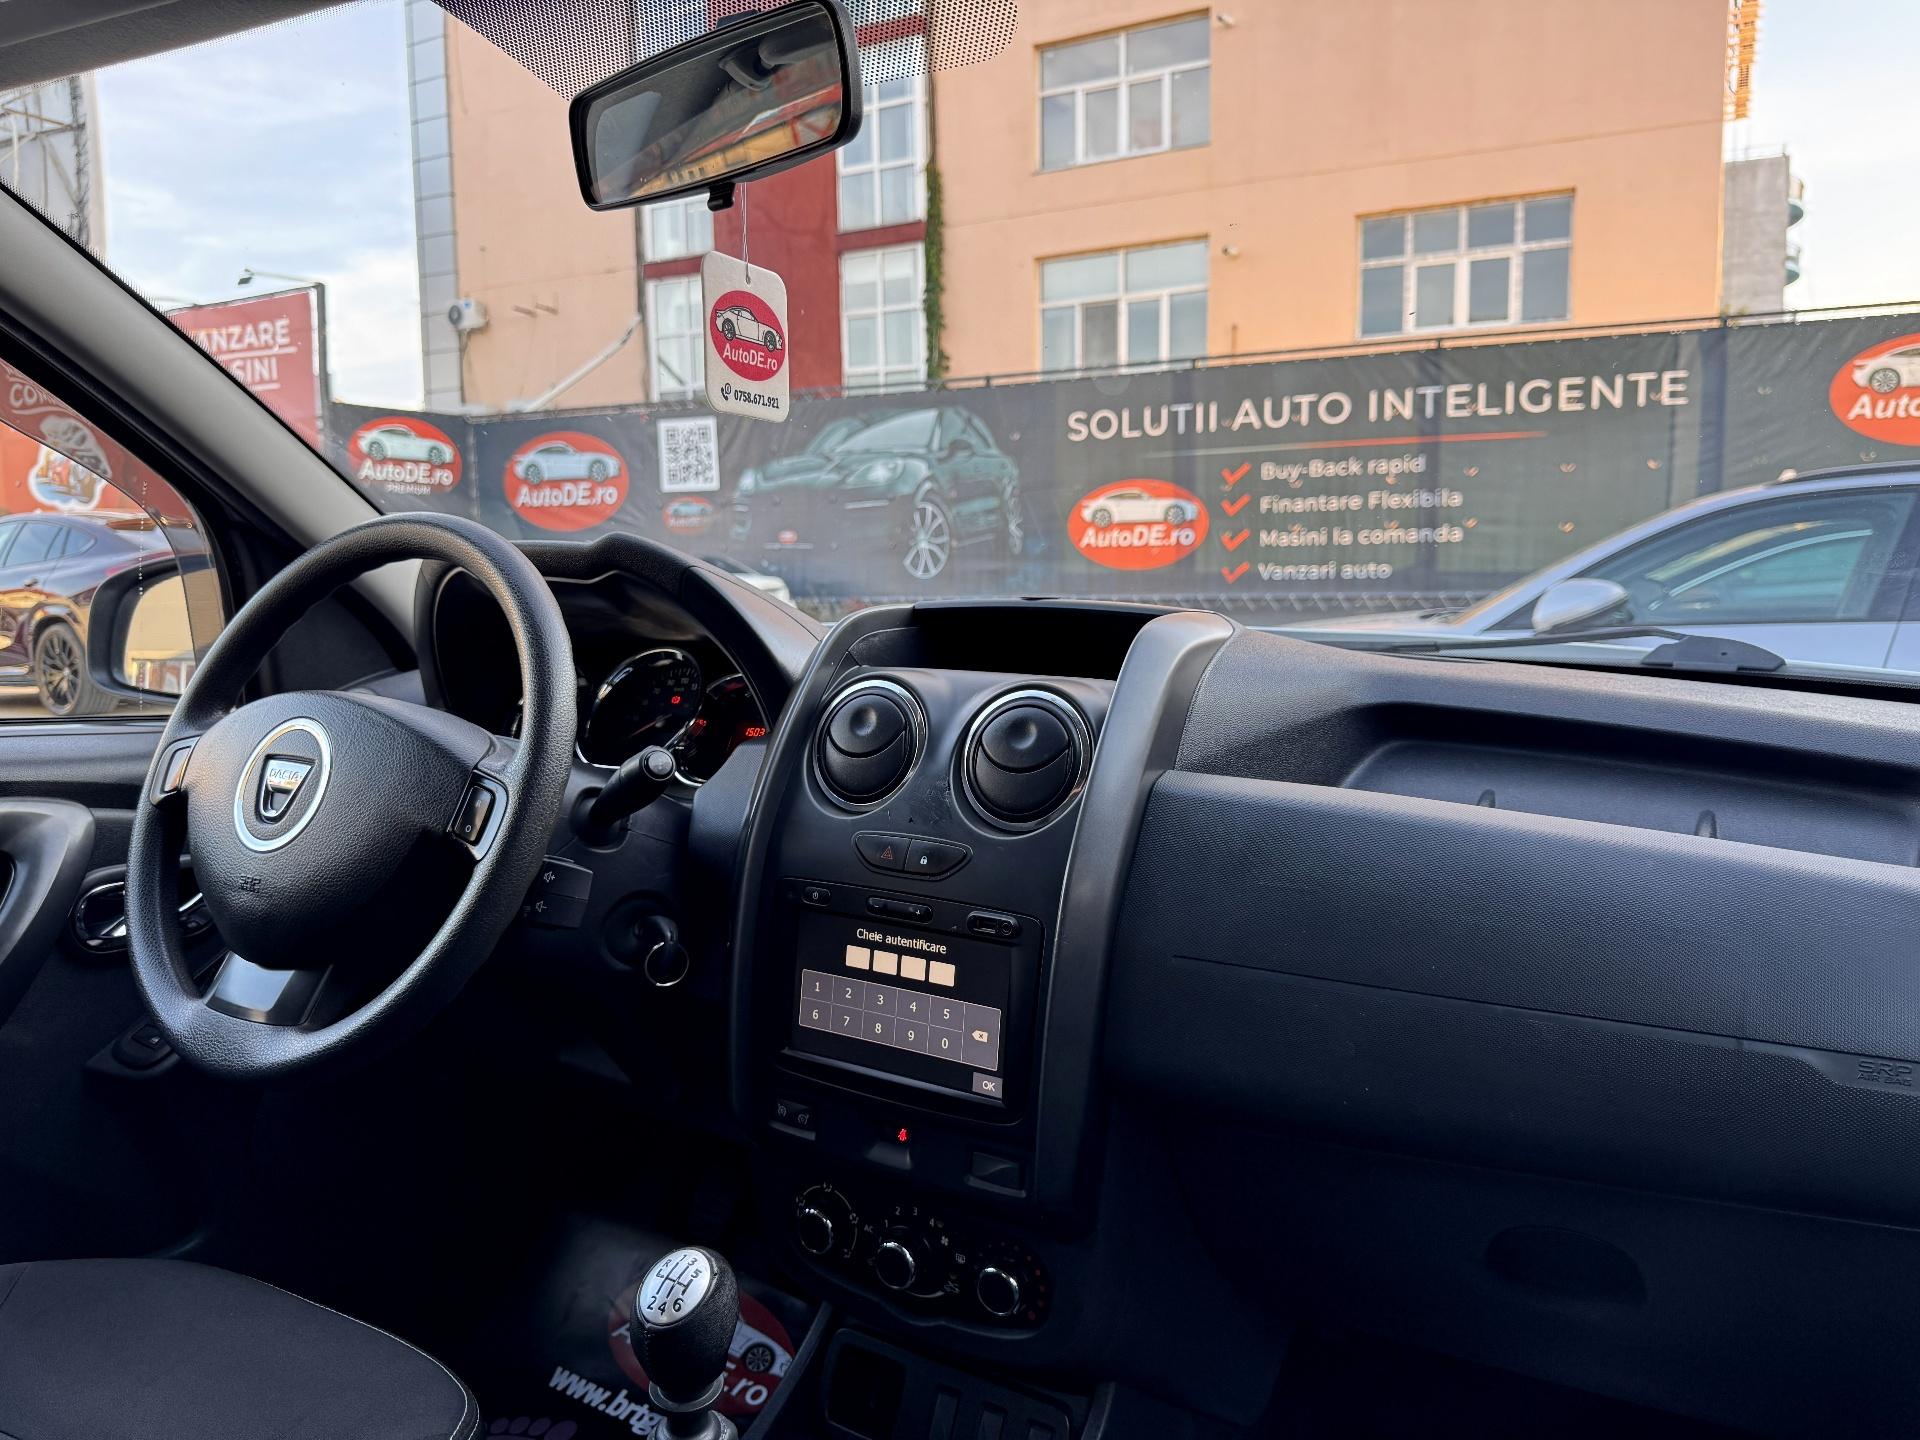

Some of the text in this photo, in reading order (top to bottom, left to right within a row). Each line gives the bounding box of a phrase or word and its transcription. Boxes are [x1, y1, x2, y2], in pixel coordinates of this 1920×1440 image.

[195, 317, 290, 352] ANZARE
[723, 343, 778, 371] AutoDE.ro
[733, 389, 780, 409] 0758.671.921
[1067, 369, 1690, 442] SOLUTII AUTO INTELIGENTE
[359, 458, 454, 486] AutoDE.ro
[1260, 454, 1427, 482] Buy-Back rapid
[517, 482, 619, 508] AutoDE.ro
[1259, 489, 1464, 514] Finantare Flexibila
[1080, 523, 1197, 549] AutoDE.ro
[1259, 523, 1464, 548] Masini la comanda
[1258, 561, 1393, 581] Vanzari auto
[856, 928, 947, 954] Cheie autentificare
[815, 982, 950, 1019] 1 2 3 4 5
[812, 1010, 819, 1020] 6
[843, 1016, 850, 1026] 7
[875, 1023, 882, 1034] 8
[908, 1030, 915, 1041] 9
[982, 1080, 995, 1091] OK
[662, 1259, 672, 1267] R
[687, 1257, 698, 1266] 3
[690, 1268, 702, 1279] 5
[647, 1295, 684, 1316] 2 4 6
